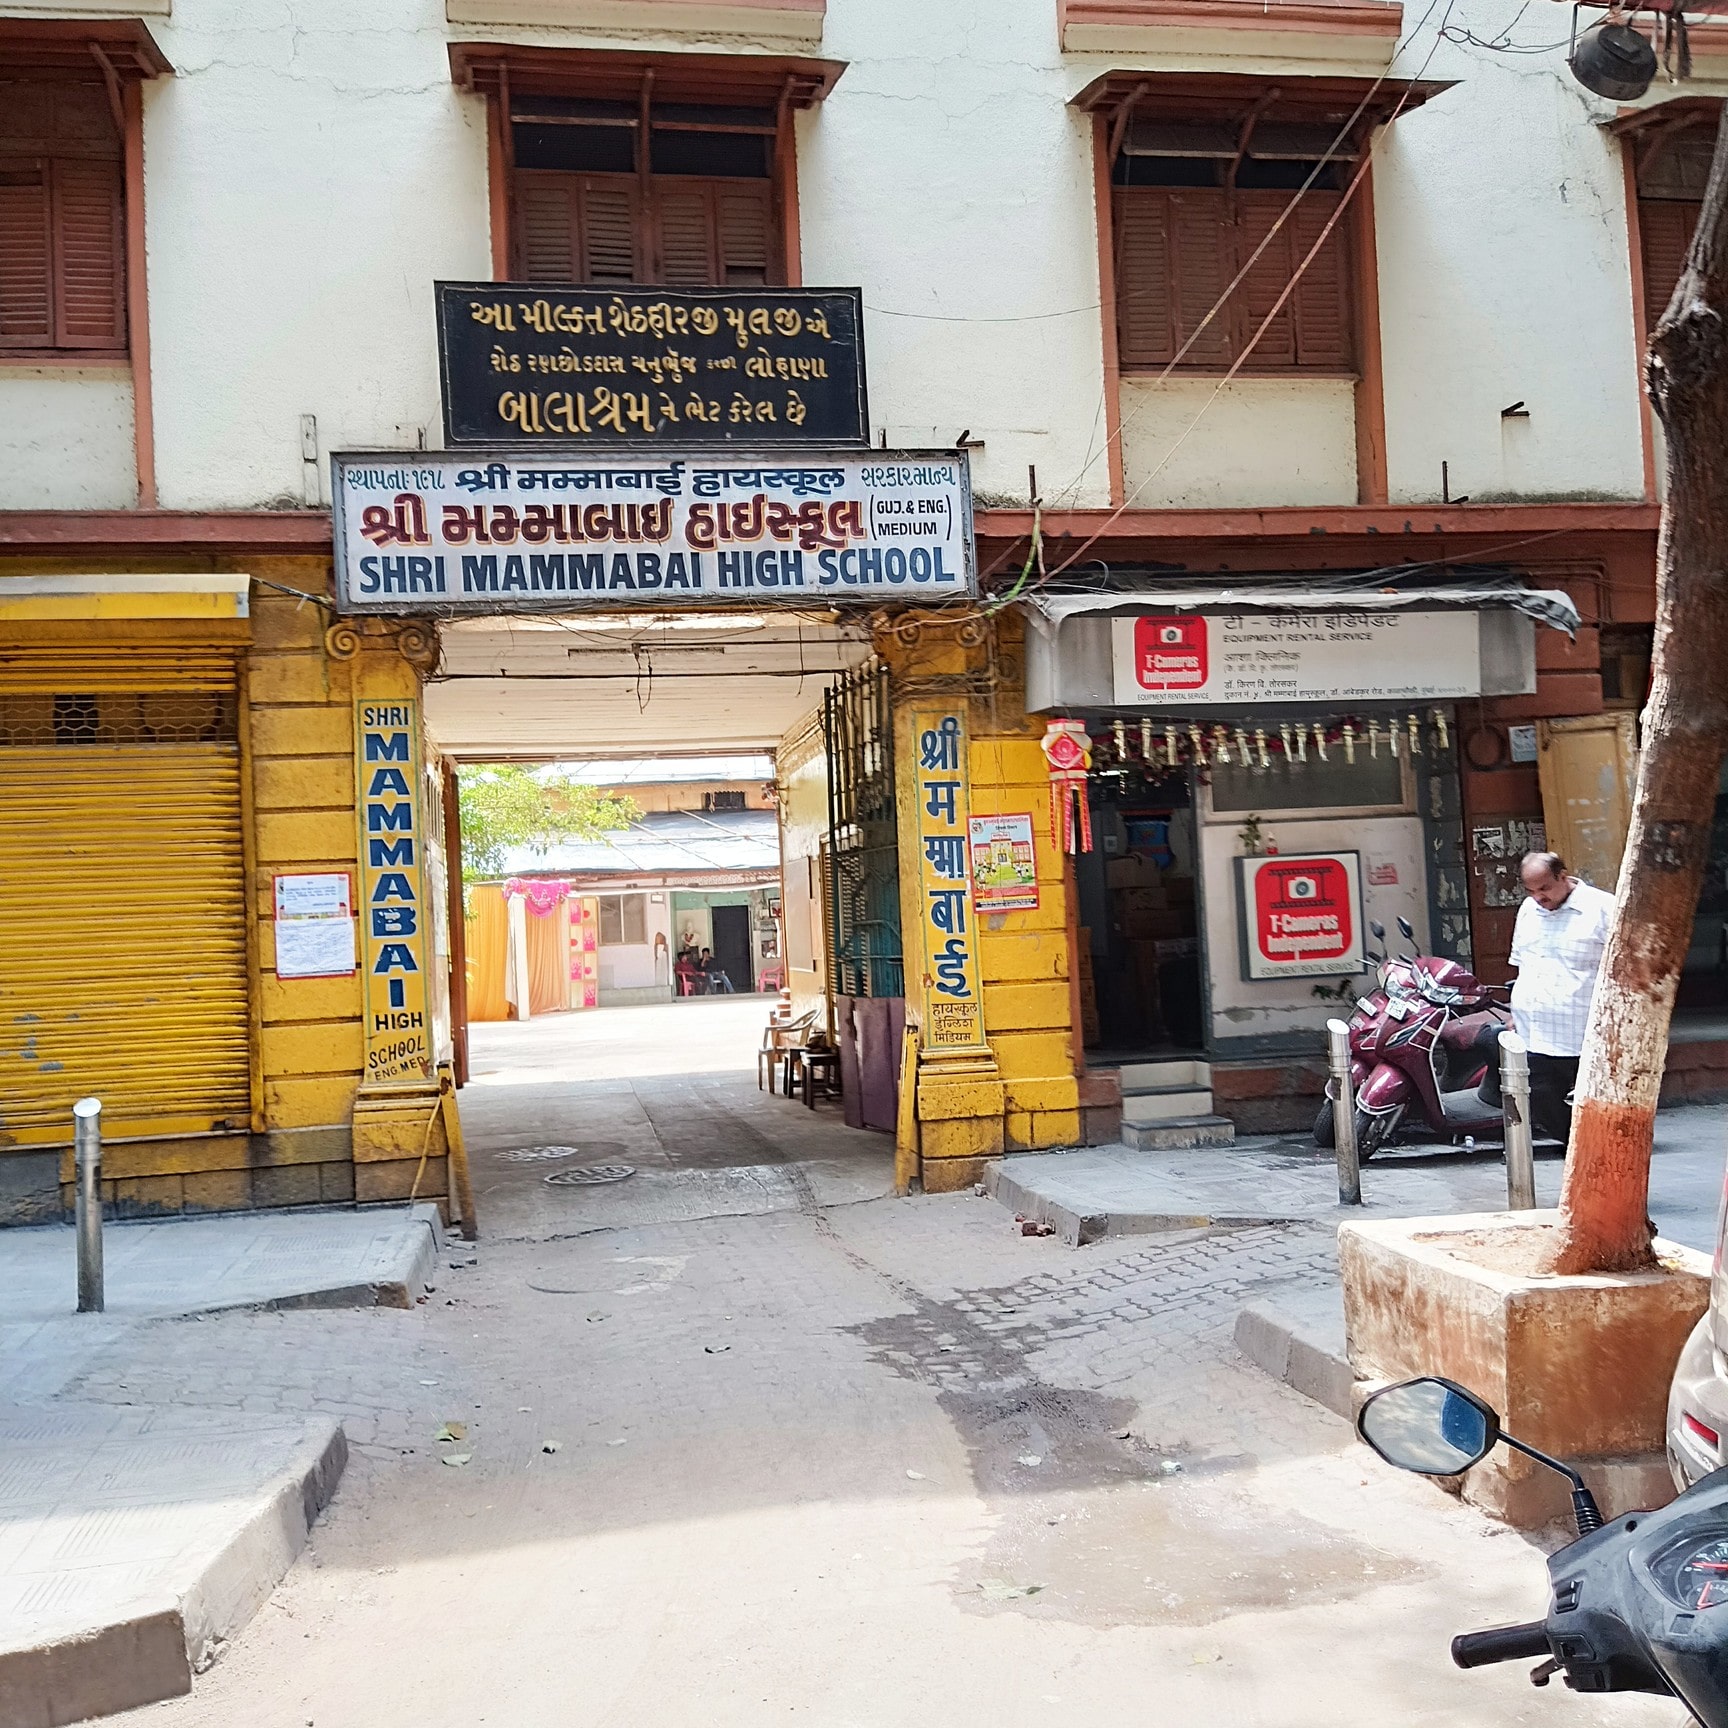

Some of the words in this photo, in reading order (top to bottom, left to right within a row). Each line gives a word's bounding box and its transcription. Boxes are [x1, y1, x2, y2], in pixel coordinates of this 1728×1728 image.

[470, 301, 517, 332] આ
[805, 307, 831, 339] એ
[498, 386, 656, 433] બાલાશ્રમ
[659, 391, 680, 422] ને
[685, 391, 721, 422] ભેટ
[728, 391, 778, 423] કરેલ
[786, 389, 807, 426] છે
[455, 462, 511, 494] श्री
[516, 461, 686, 496] मम्माबाई
[692, 468, 845, 497] हायस्कूल
[861, 466, 956, 488] સરકારમાન્ય
[359, 492, 431, 548] શ્રી
[441, 497, 674, 545] મમ્માબાઈ
[684, 493, 867, 550] હાઈસ્કૂલ
[877, 521, 938, 537] MEDIUM
[359, 555, 446, 594] SHRI
[461, 551, 702, 592] MAMMABAI
[717, 550, 804, 588] HIGH
[818, 546, 956, 586] SCHOOL
[1223, 633, 1283, 643] EQUIPMENT
[1286, 633, 1327, 642] RENTAL
[1328, 632, 1373, 641] SERVICE
[364, 706, 410, 727] SHRI
[920, 716, 961, 770] श्री
[364, 732, 419, 1009] MAMMABAI
[375, 1011, 423, 1031] HIGH
[368, 1035, 426, 1069] SCHOOL
[374, 1065, 398, 1081] ENG
